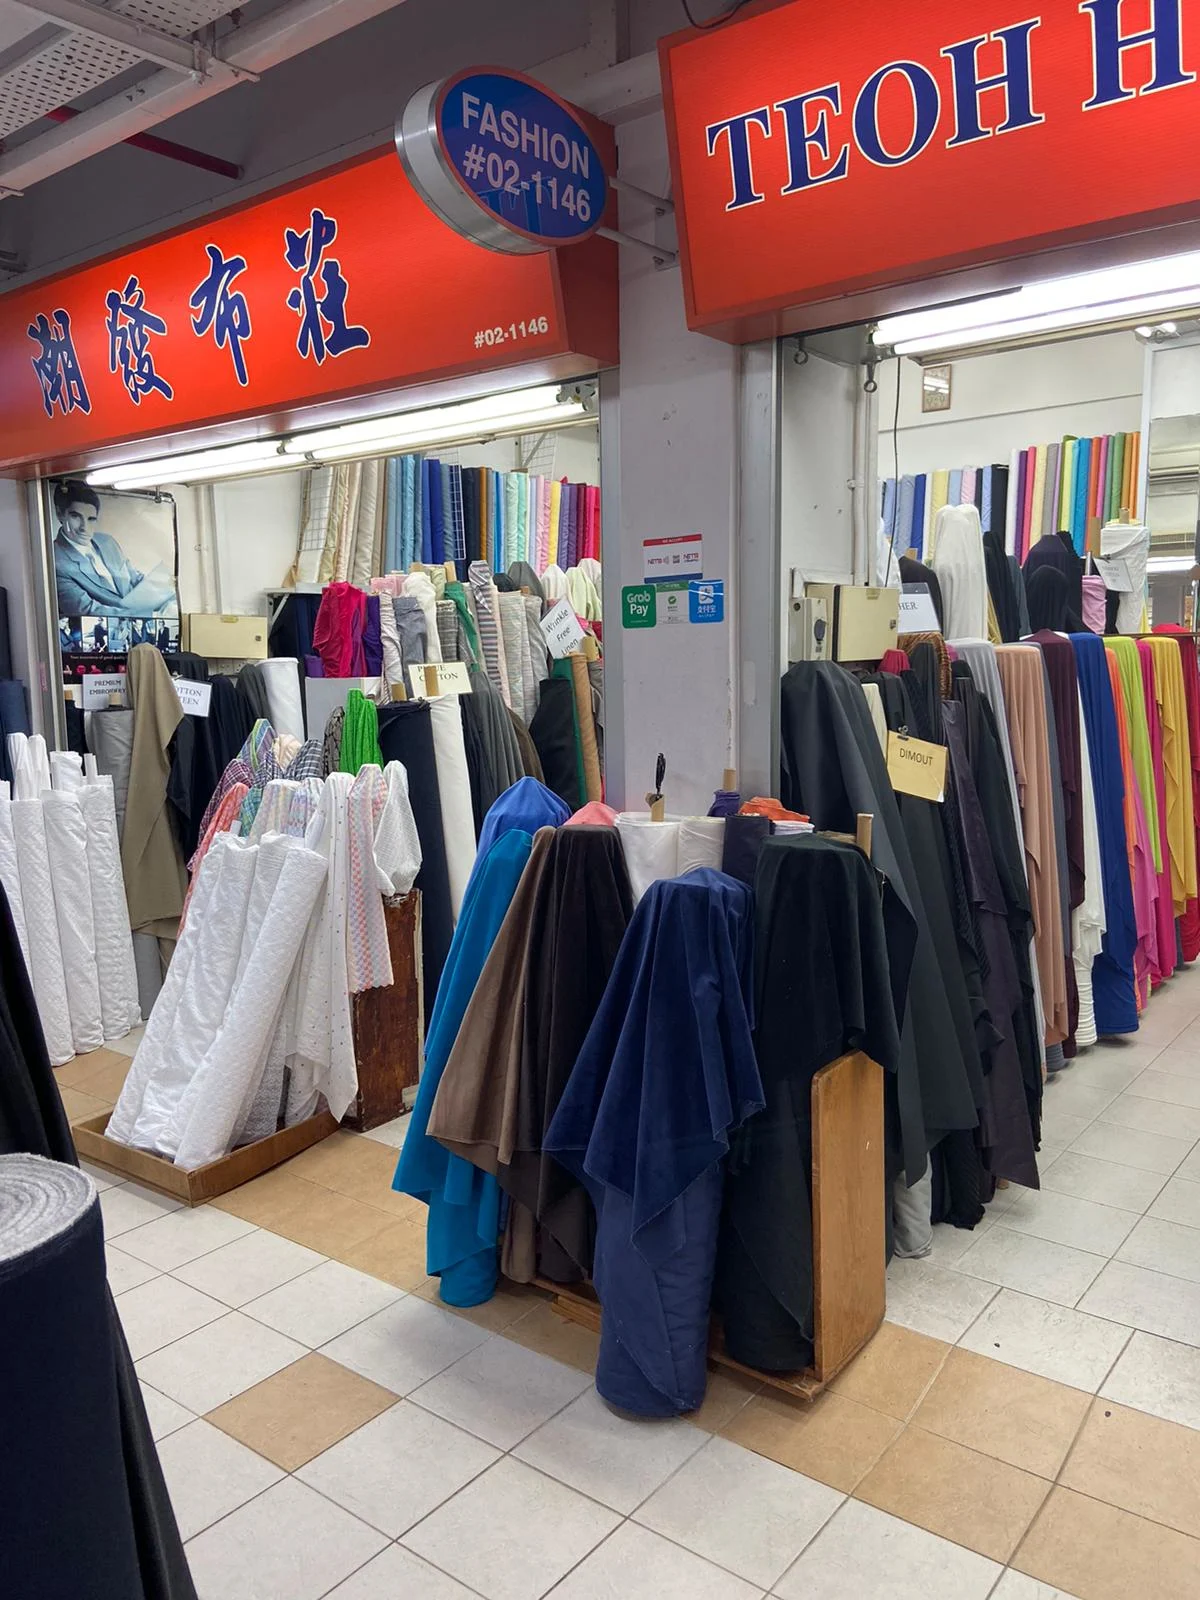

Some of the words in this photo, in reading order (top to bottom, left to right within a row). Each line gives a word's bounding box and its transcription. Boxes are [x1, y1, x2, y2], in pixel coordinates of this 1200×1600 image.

[706, 16, 1045, 211] TEOH
[461, 91, 589, 180] FASHION
[463, 143, 591, 222] #02-1146
[630, 603, 649, 617] Pay
[545, 609, 569, 633] Wrinkle
[556, 626, 571, 642] Free
[419, 672, 459, 682] CTON
[899, 748, 933, 766] DIMOUT
